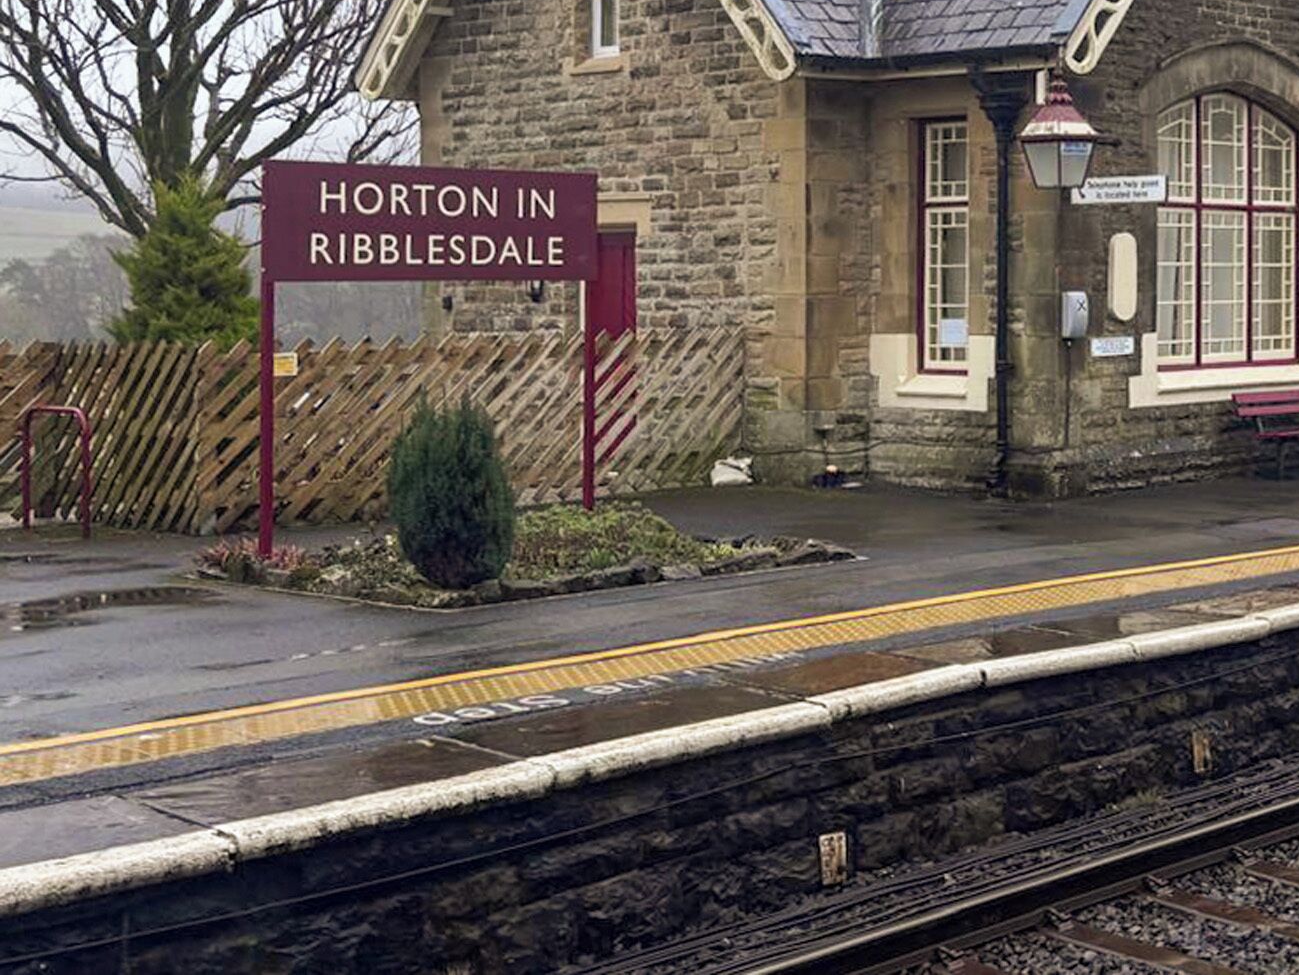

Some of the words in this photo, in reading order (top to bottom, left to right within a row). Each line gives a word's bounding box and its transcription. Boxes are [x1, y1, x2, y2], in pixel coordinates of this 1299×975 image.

[320, 180, 498, 218] HORTON
[517, 187, 556, 220] IN
[310, 232, 564, 266] RIBBLESDALE
[412, 694, 571, 726] Step
